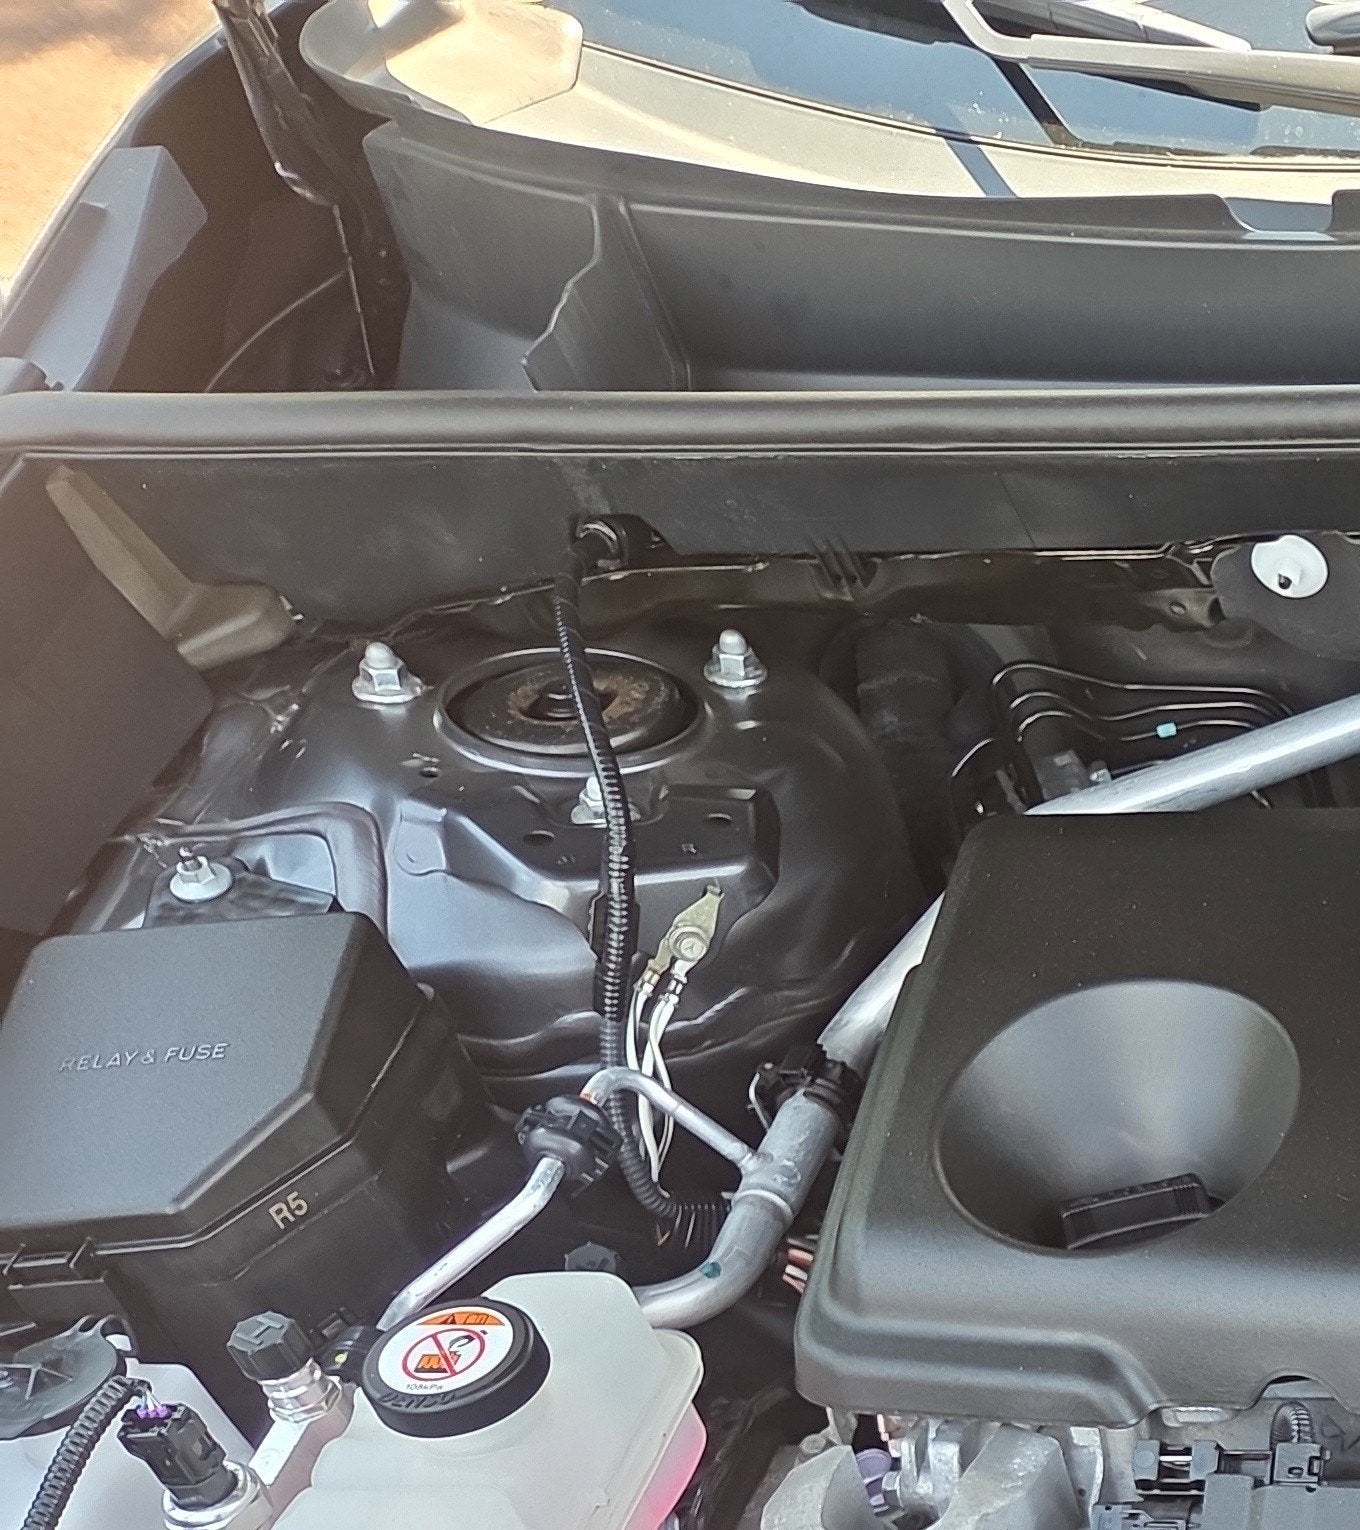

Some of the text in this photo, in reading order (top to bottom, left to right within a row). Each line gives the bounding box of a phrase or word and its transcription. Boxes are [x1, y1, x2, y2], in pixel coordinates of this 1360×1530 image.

[59, 1042, 230, 1072] RELAY & FUSE
[268, 1190, 308, 1230] R5
